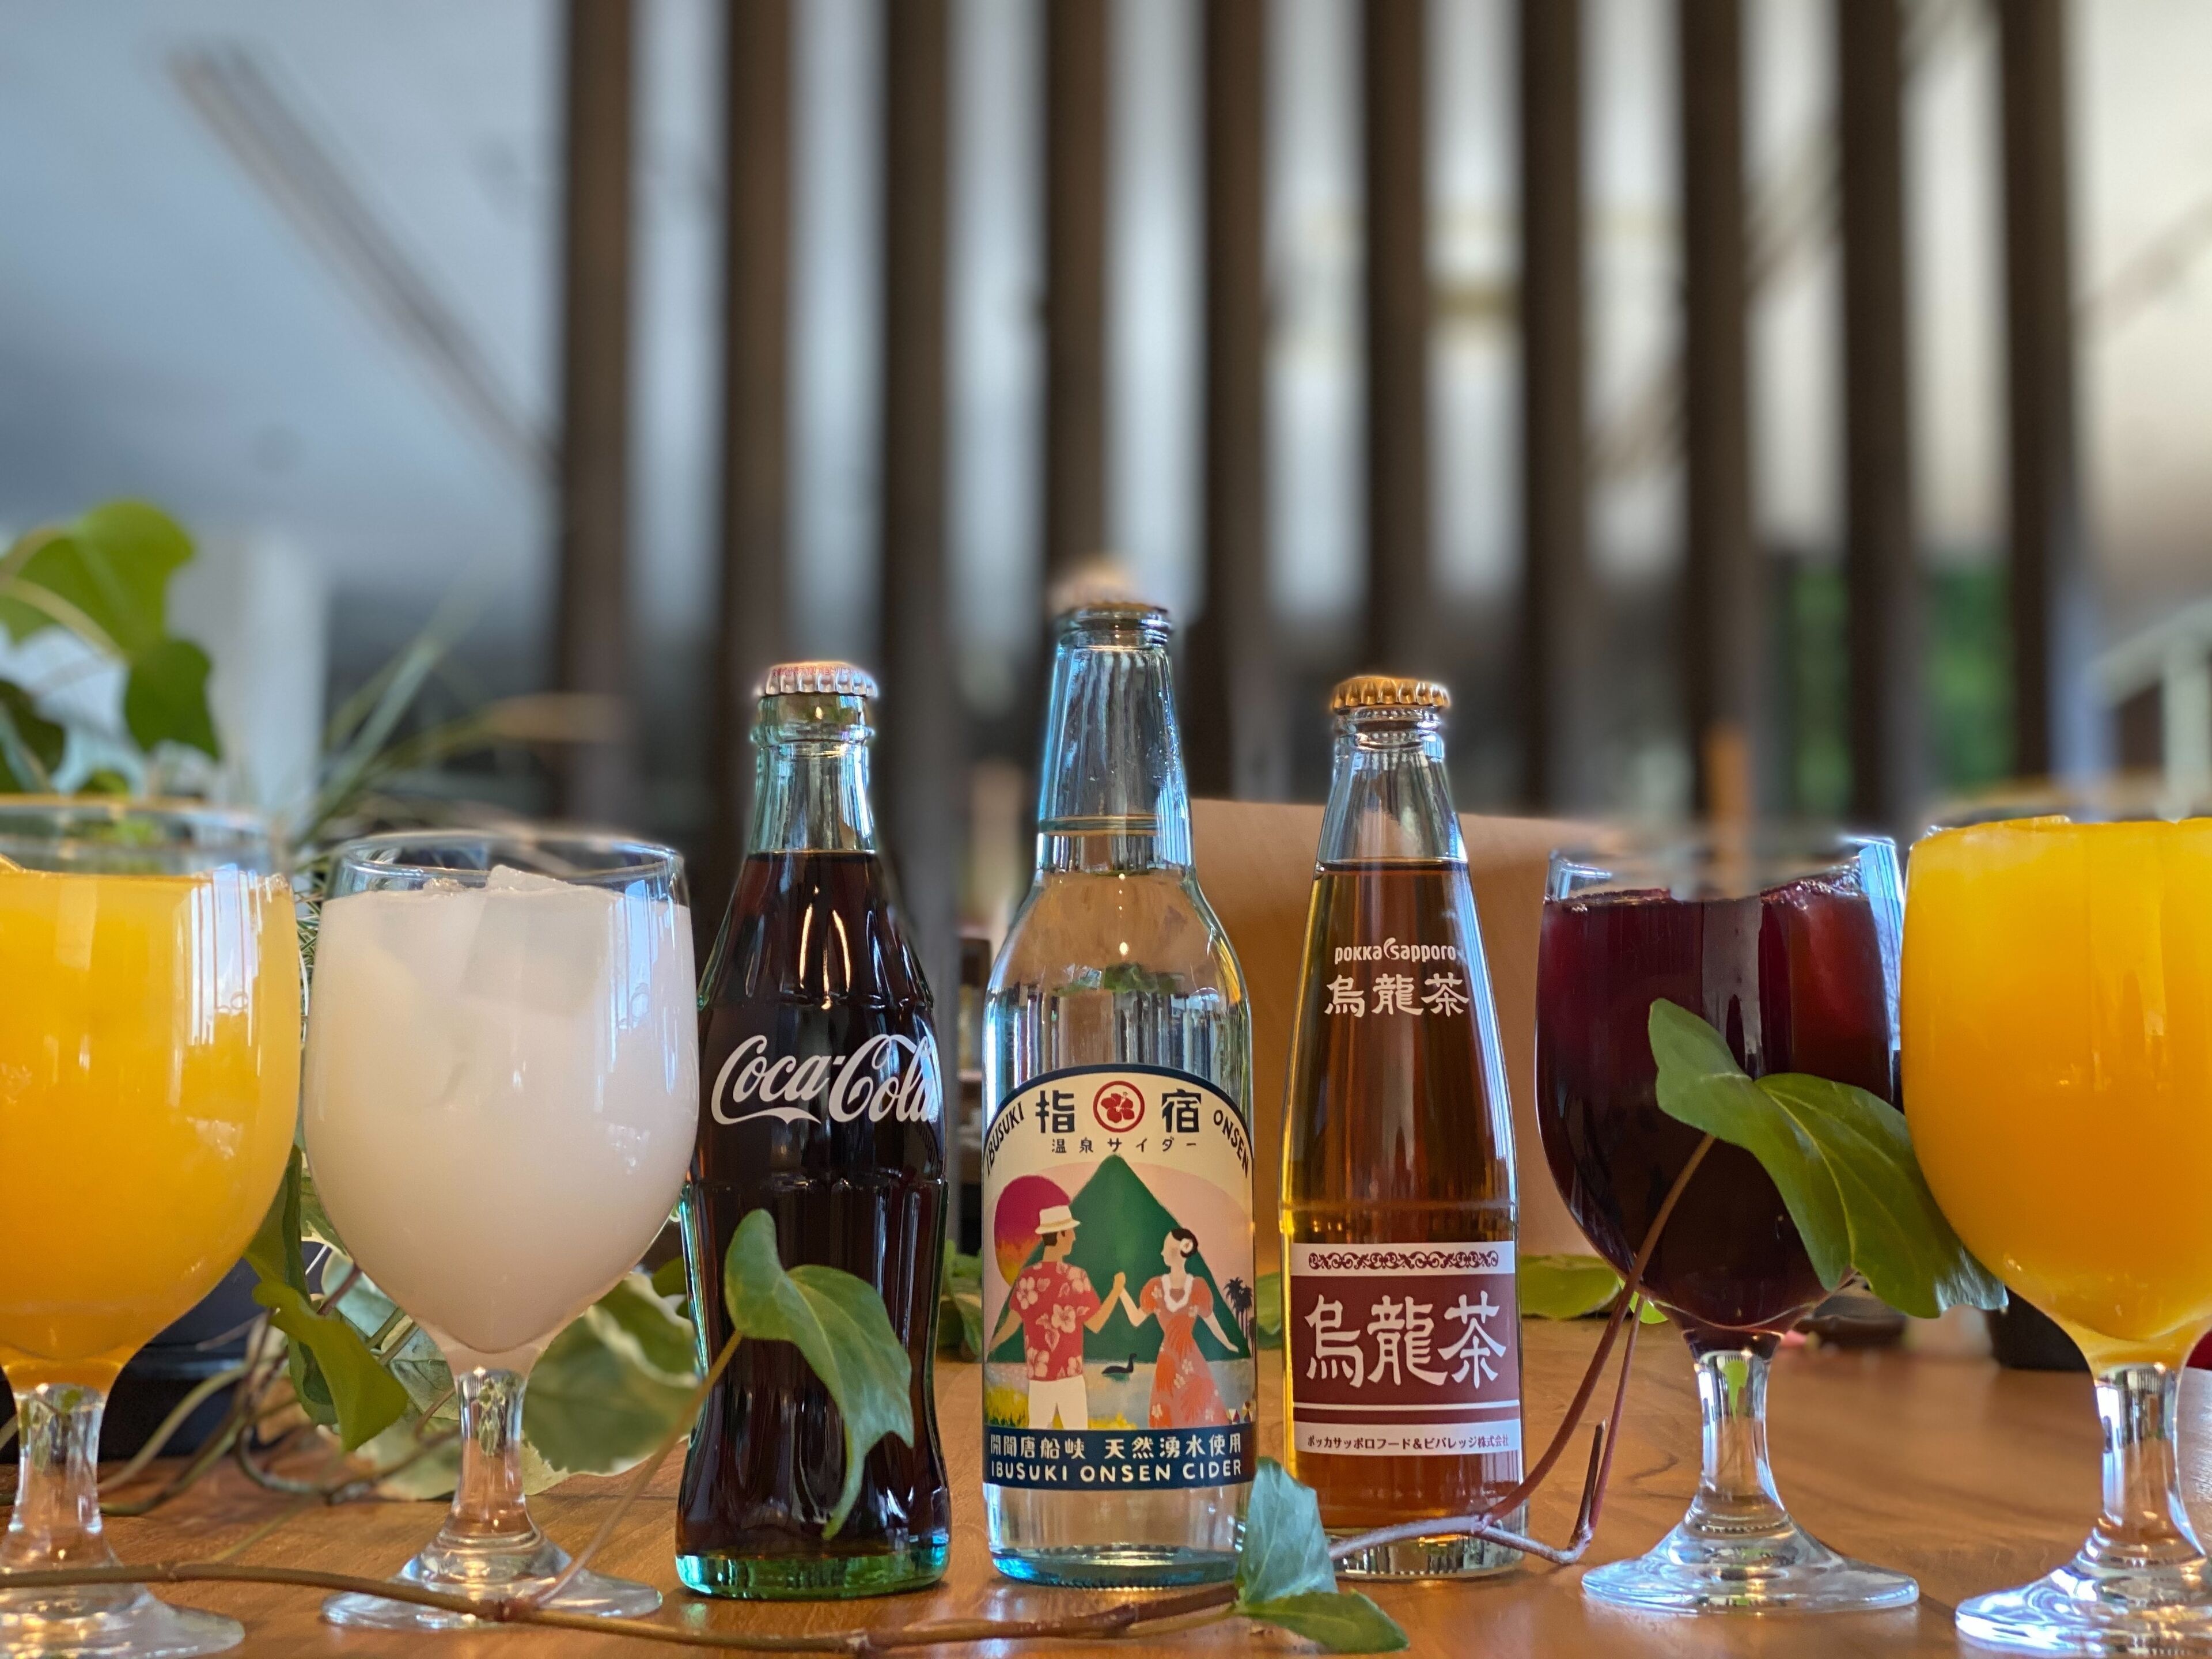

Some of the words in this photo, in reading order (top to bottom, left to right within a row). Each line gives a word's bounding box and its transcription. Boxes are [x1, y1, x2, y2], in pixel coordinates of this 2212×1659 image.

[1324, 972, 1469, 1017] 烏龍茶
[711, 1035, 938, 1126] Coca-Cola
[986, 1101, 1024, 1179] IBUSUKI
[1213, 1109, 1249, 1179] ONSEN
[1051, 1137, 1196, 1154] 温泉サイダー
[1304, 1290, 1507, 1389] 烏龍茶
[991, 1460, 1067, 1482] IBUSUKI
[1080, 1464, 1171, 1483] ONSEN
[1183, 1459, 1241, 1479] CIDER
